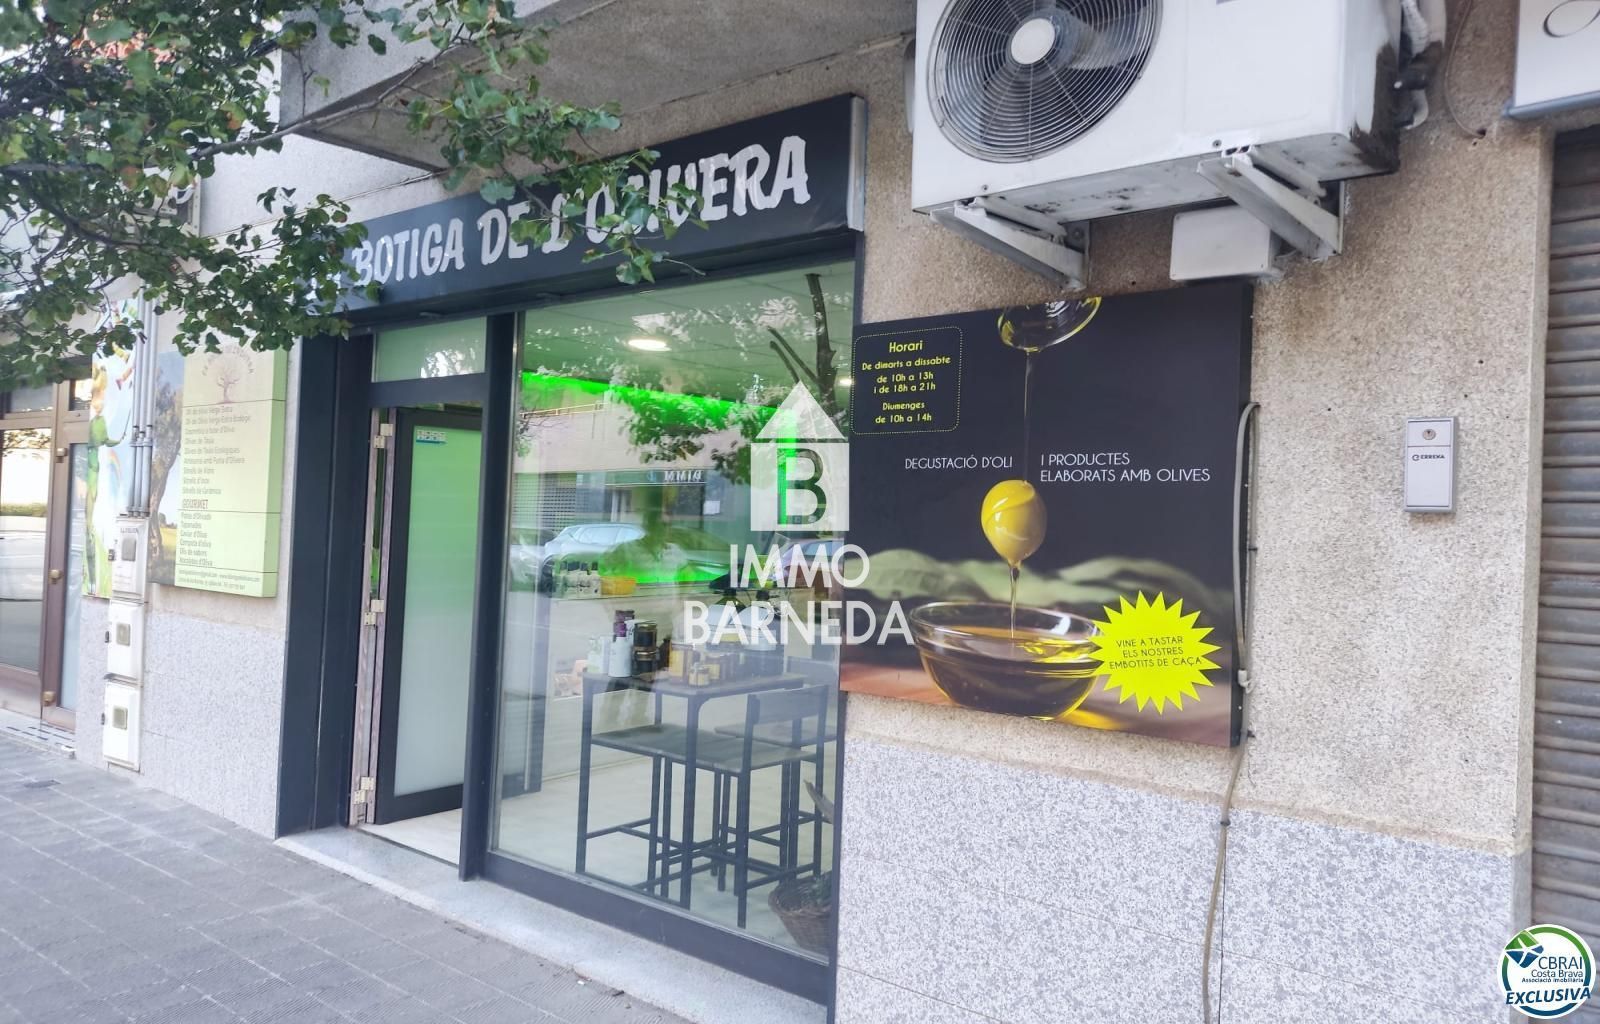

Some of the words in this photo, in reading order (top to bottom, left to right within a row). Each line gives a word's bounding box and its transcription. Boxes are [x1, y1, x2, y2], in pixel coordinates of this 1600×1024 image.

[351, 217, 465, 287] BOTIGA
[477, 201, 530, 266] DE
[889, 340, 923, 353] Horari
[862, 362, 872, 371] De
[874, 360, 903, 370] dimarts
[914, 356, 951, 366] dissabte
[877, 375, 887, 384] de
[892, 373, 906, 383] 10h
[919, 371, 934, 381] 13h
[879, 385, 890, 394] de
[894, 384, 908, 393] 18h
[919, 382, 936, 391] 21h
[882, 402, 925, 411] Diumenges
[875, 415, 886, 424] de
[890, 414, 905, 423] 10h
[917, 413, 932, 422] 14h
[904, 454, 978, 470] DEGUSTACIÓ
[981, 455, 1013, 469] D'OLI
[1049, 452, 1130, 466] PRODUCTES
[1040, 469, 1116, 483] ELABORATS
[1120, 469, 1151, 482] AMB
[1156, 468, 1211, 482] OLIVES
[1116, 639, 1137, 648] VINE
[1149, 635, 1184, 646] TASTAR
[1122, 649, 1139, 658] ELS
[1141, 647, 1184, 657] NOSTRES
[1109, 659, 1154, 669] EMBOTITS
[1157, 658, 1169, 667] DE
[1172, 656, 1202, 666] CAÇA
